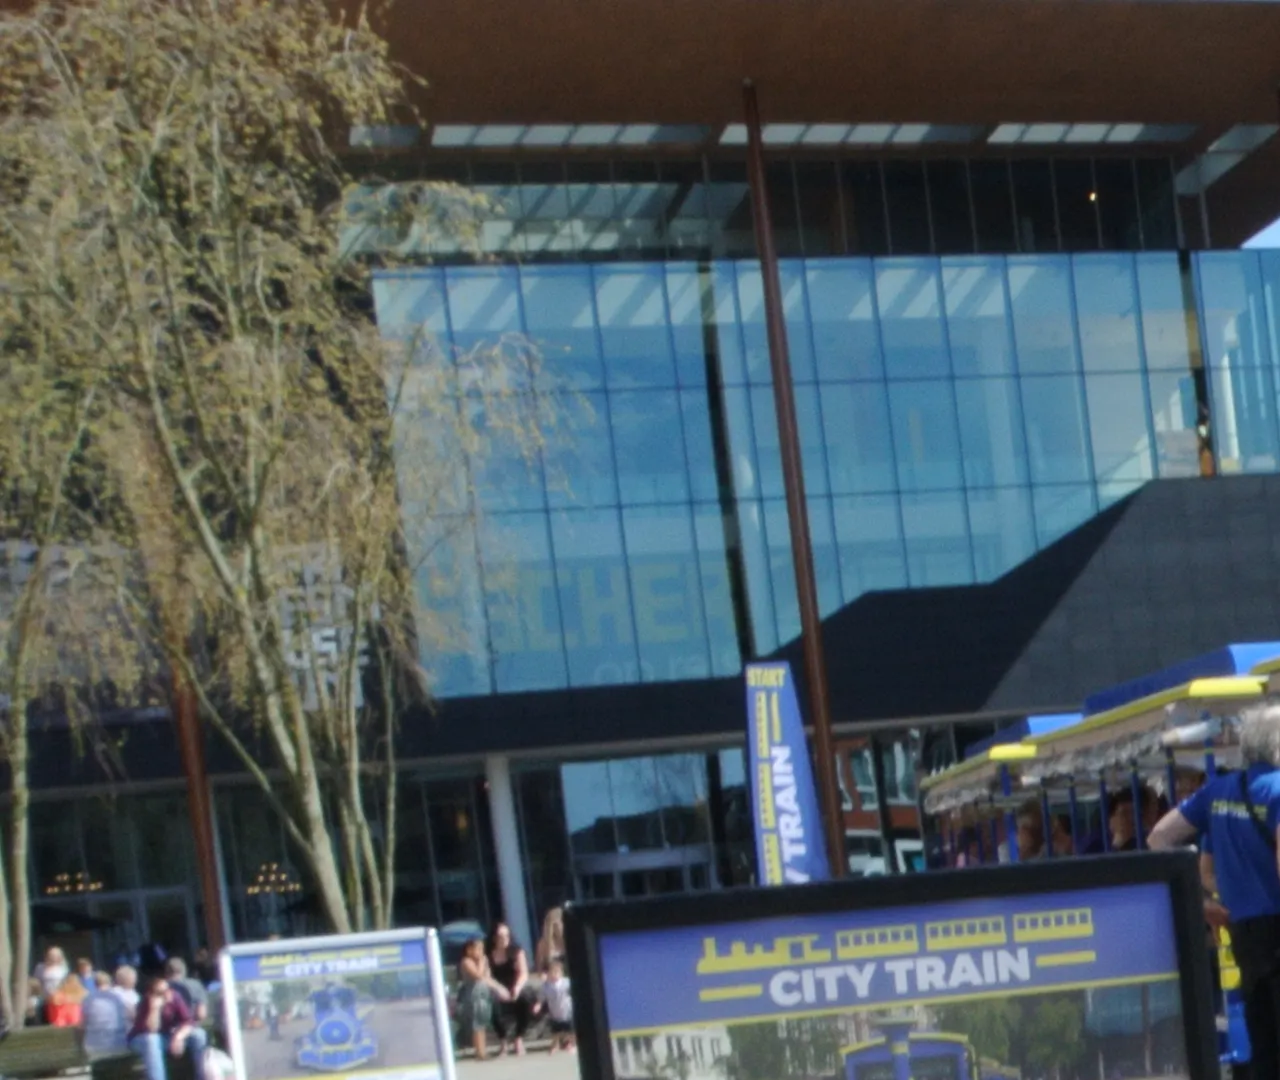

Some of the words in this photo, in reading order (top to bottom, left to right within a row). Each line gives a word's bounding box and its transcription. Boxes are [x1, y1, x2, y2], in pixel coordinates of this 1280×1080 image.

[770, 745, 807, 863] TRAIN
[284, 962, 326, 978] CITY
[328, 956, 379, 973] TRAIN
[768, 962, 877, 1007] CITY
[884, 947, 1032, 995] TRAIN
